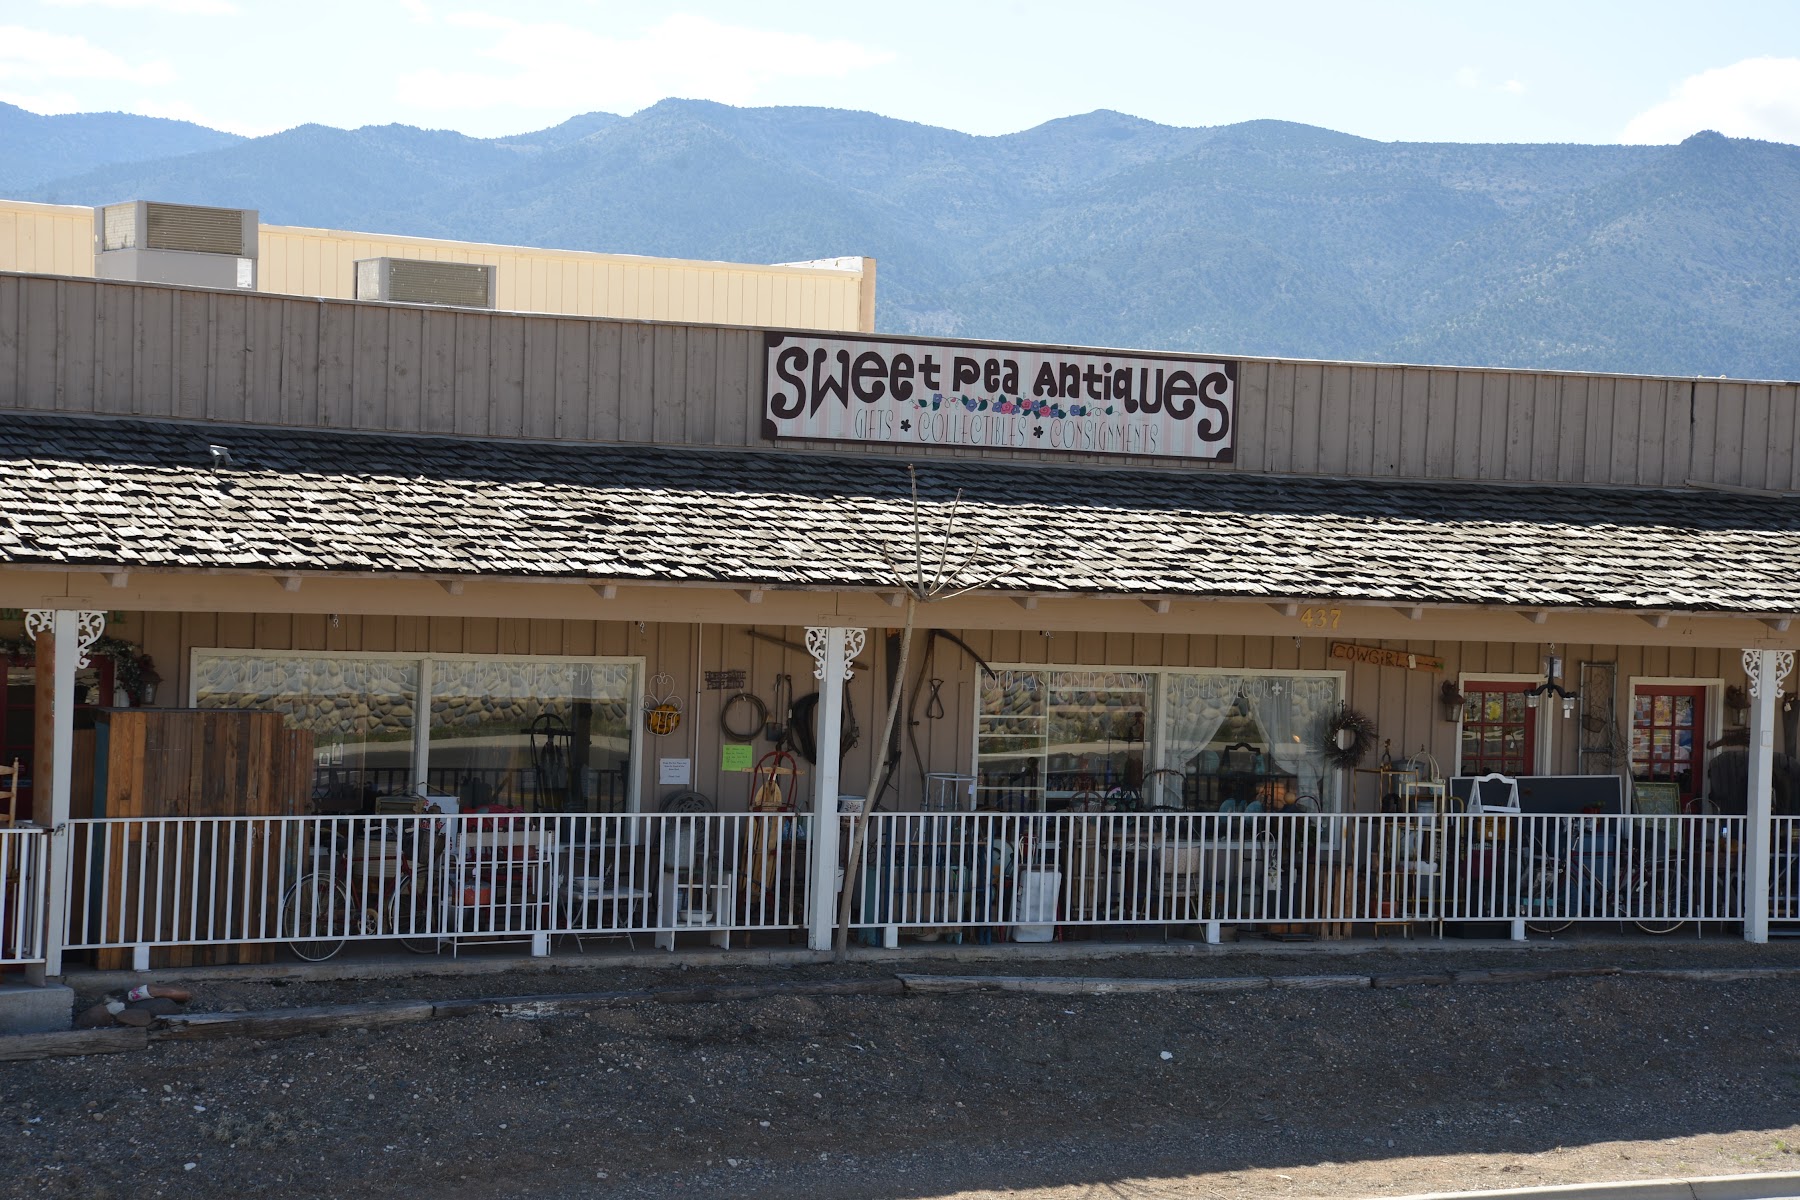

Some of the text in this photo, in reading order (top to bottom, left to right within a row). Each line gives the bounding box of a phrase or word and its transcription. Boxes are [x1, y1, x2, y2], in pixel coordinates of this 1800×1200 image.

[855, 409, 1158, 453] GIFTS COLLECTIBLES CONSIGNMENTS
[1300, 607, 1342, 629] 437
[519, 662, 561, 686] GIFTS
[580, 663, 630, 687] DOLLS
[984, 670, 1014, 691] OLD
[1171, 677, 1225, 699] WESTERN
[1228, 678, 1272, 700] DECOR
